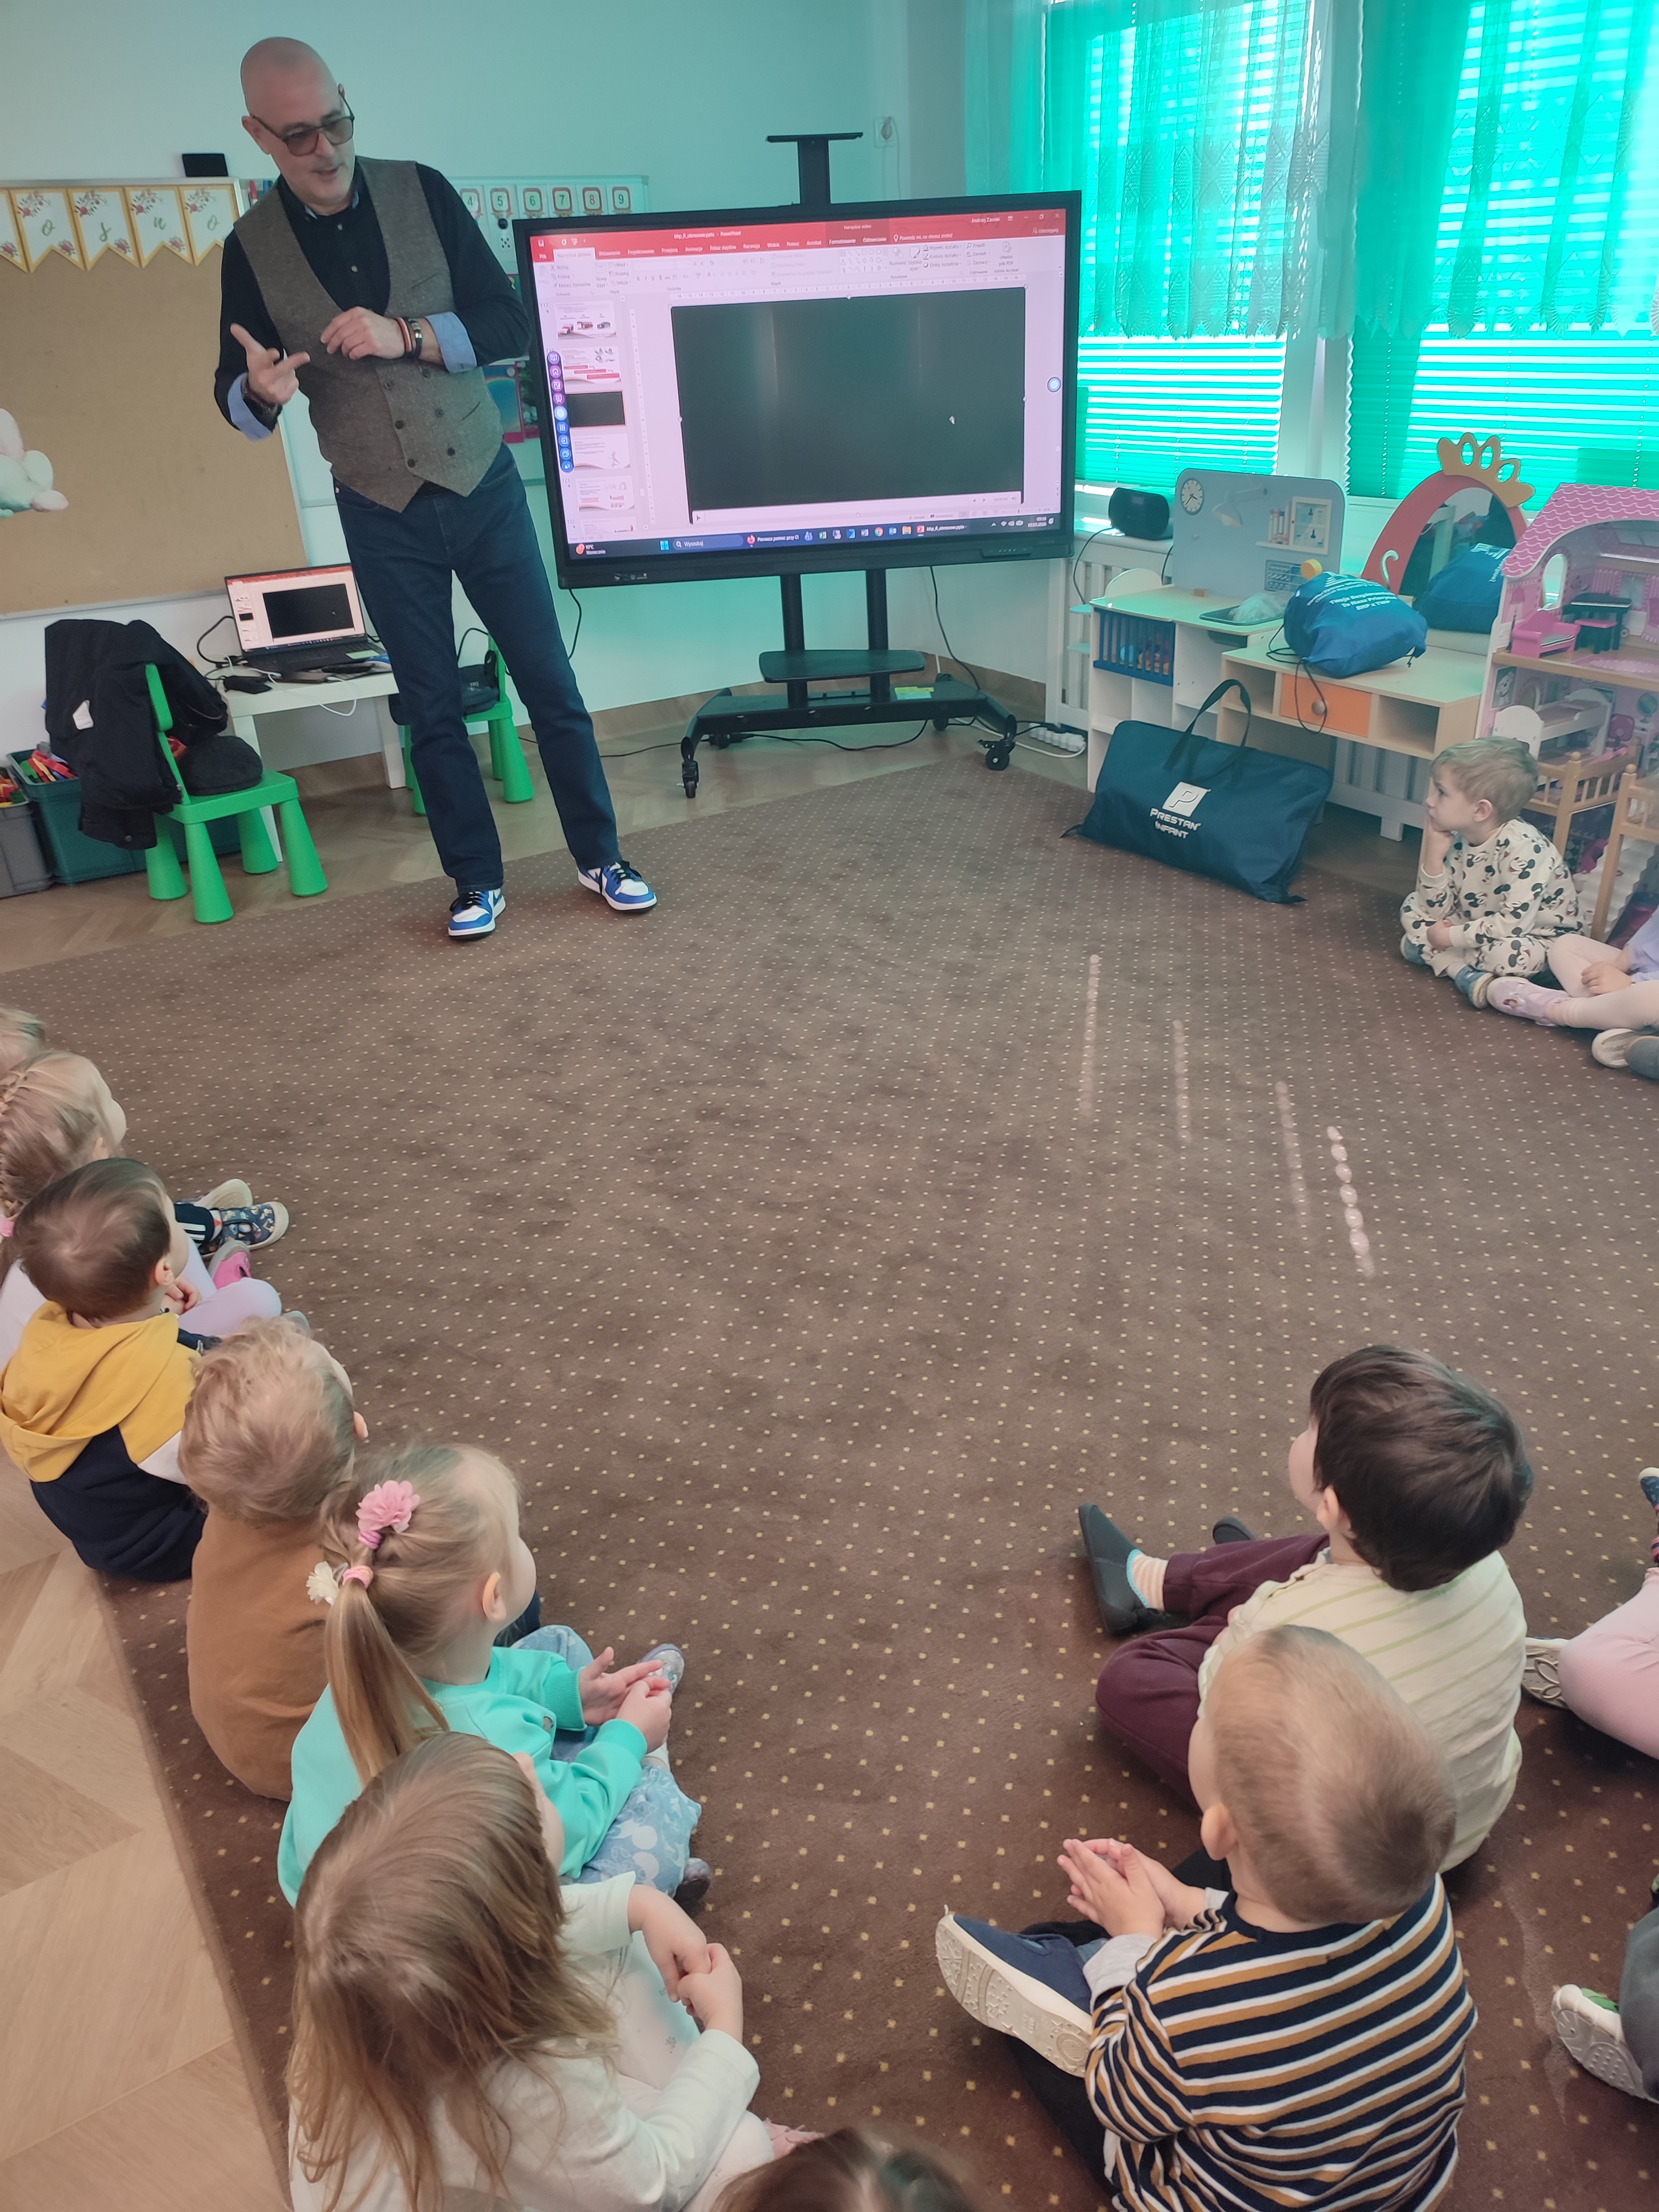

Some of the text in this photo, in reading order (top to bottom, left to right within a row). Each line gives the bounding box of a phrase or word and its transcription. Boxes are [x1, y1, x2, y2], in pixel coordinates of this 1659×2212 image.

[467, 196, 474, 207] 4
[497, 195, 503, 206] 5
[529, 195, 536, 206] 6
[559, 194, 565, 205] 7
[589, 194, 595, 205] 8
[618, 194, 624, 205] 9
[1150, 807, 1199, 831] PRESTAN
[1155, 821, 1189, 839] INFANT
